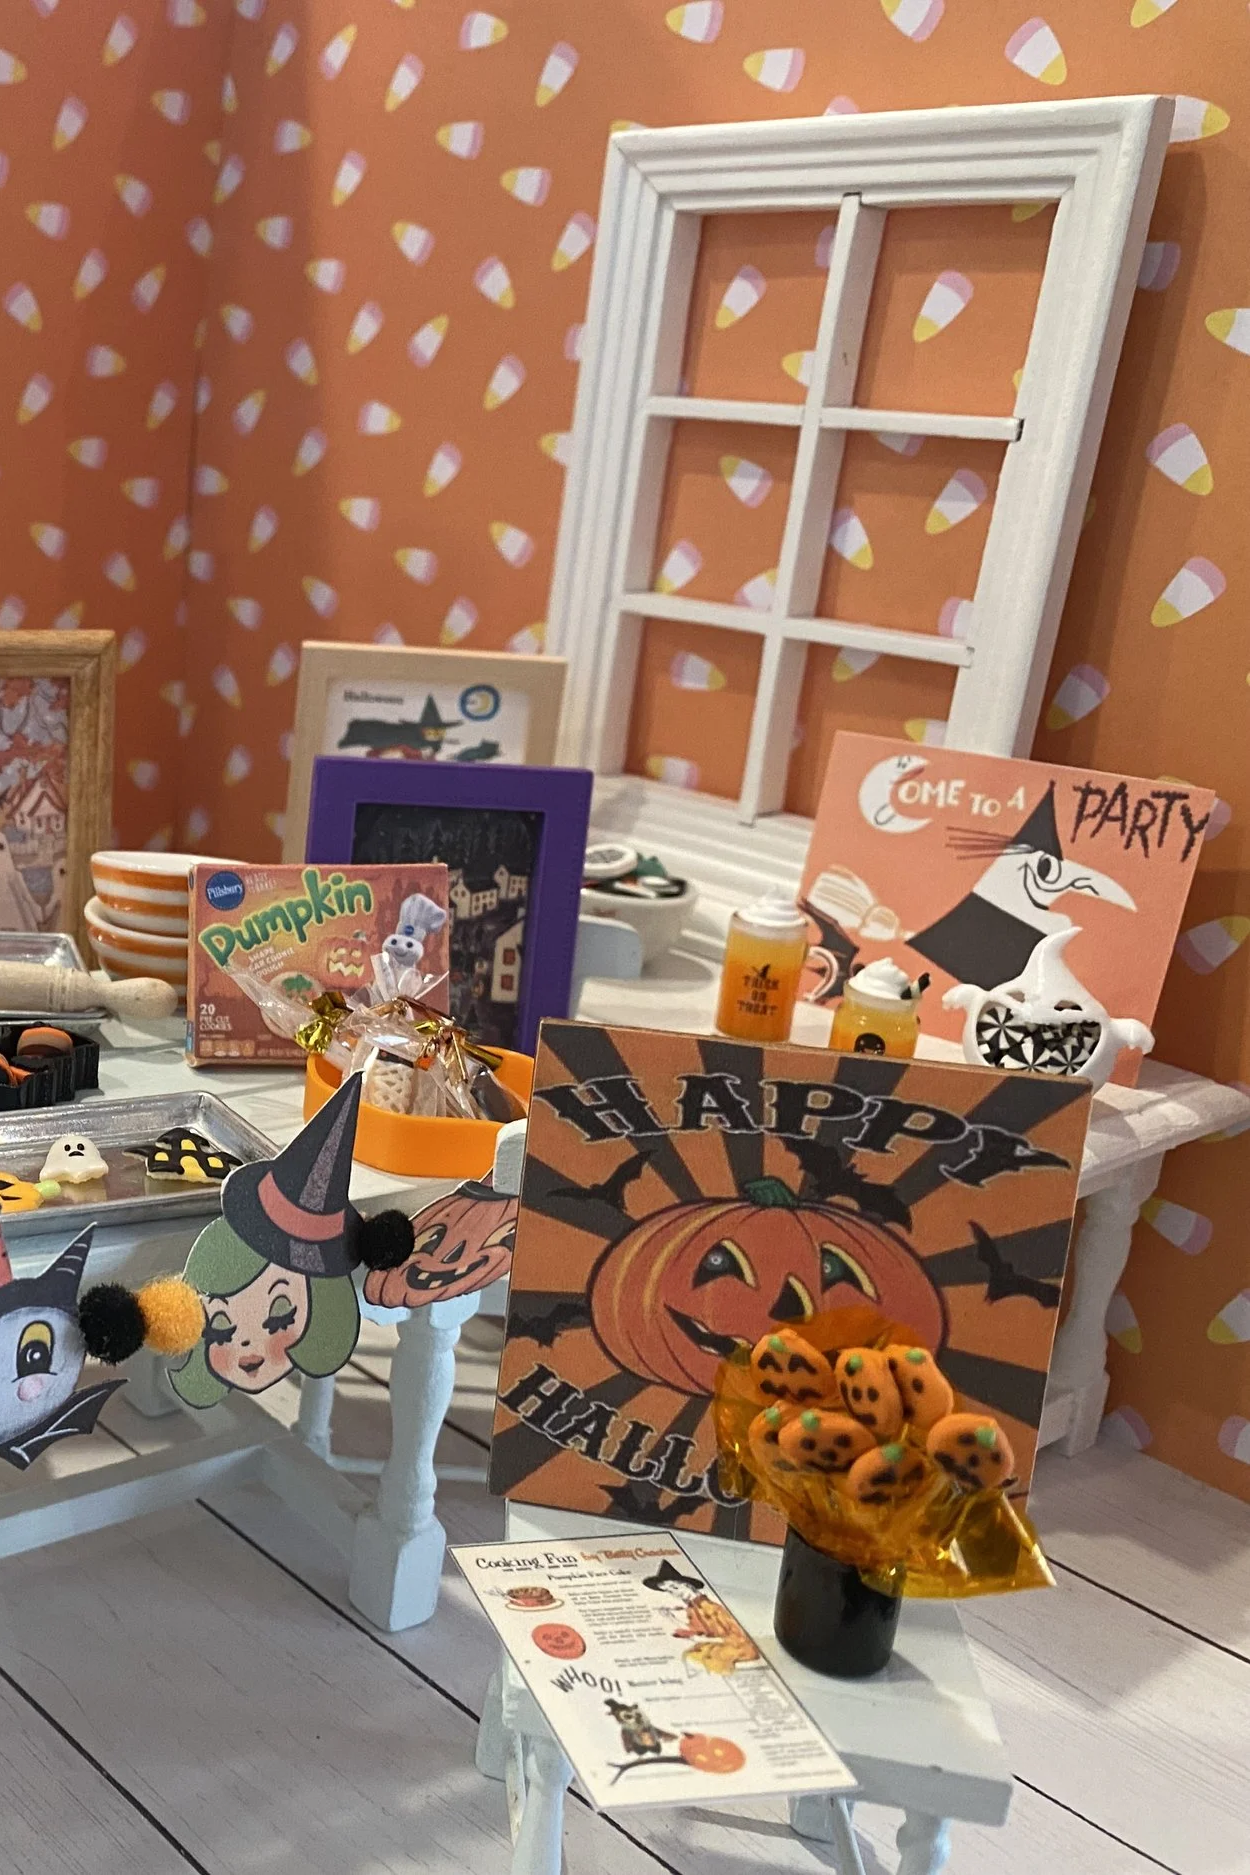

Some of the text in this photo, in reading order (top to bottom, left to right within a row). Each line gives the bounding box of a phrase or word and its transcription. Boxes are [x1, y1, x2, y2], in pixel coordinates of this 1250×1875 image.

[969, 792, 1002, 818] TO
[1007, 785, 1027, 811] A
[1069, 779, 1211, 863] PARTY
[207, 884, 243, 900] Pillsbury
[198, 867, 374, 968] Pumpkin
[200, 1004, 215, 1015] 20
[531, 1072, 1073, 1188] HAPPY
[476, 1556, 544, 1570] Cooking
[543, 1552, 578, 1566] Fun
[580, 1551, 603, 1563] by
[550, 1664, 623, 1697] WHOO!
